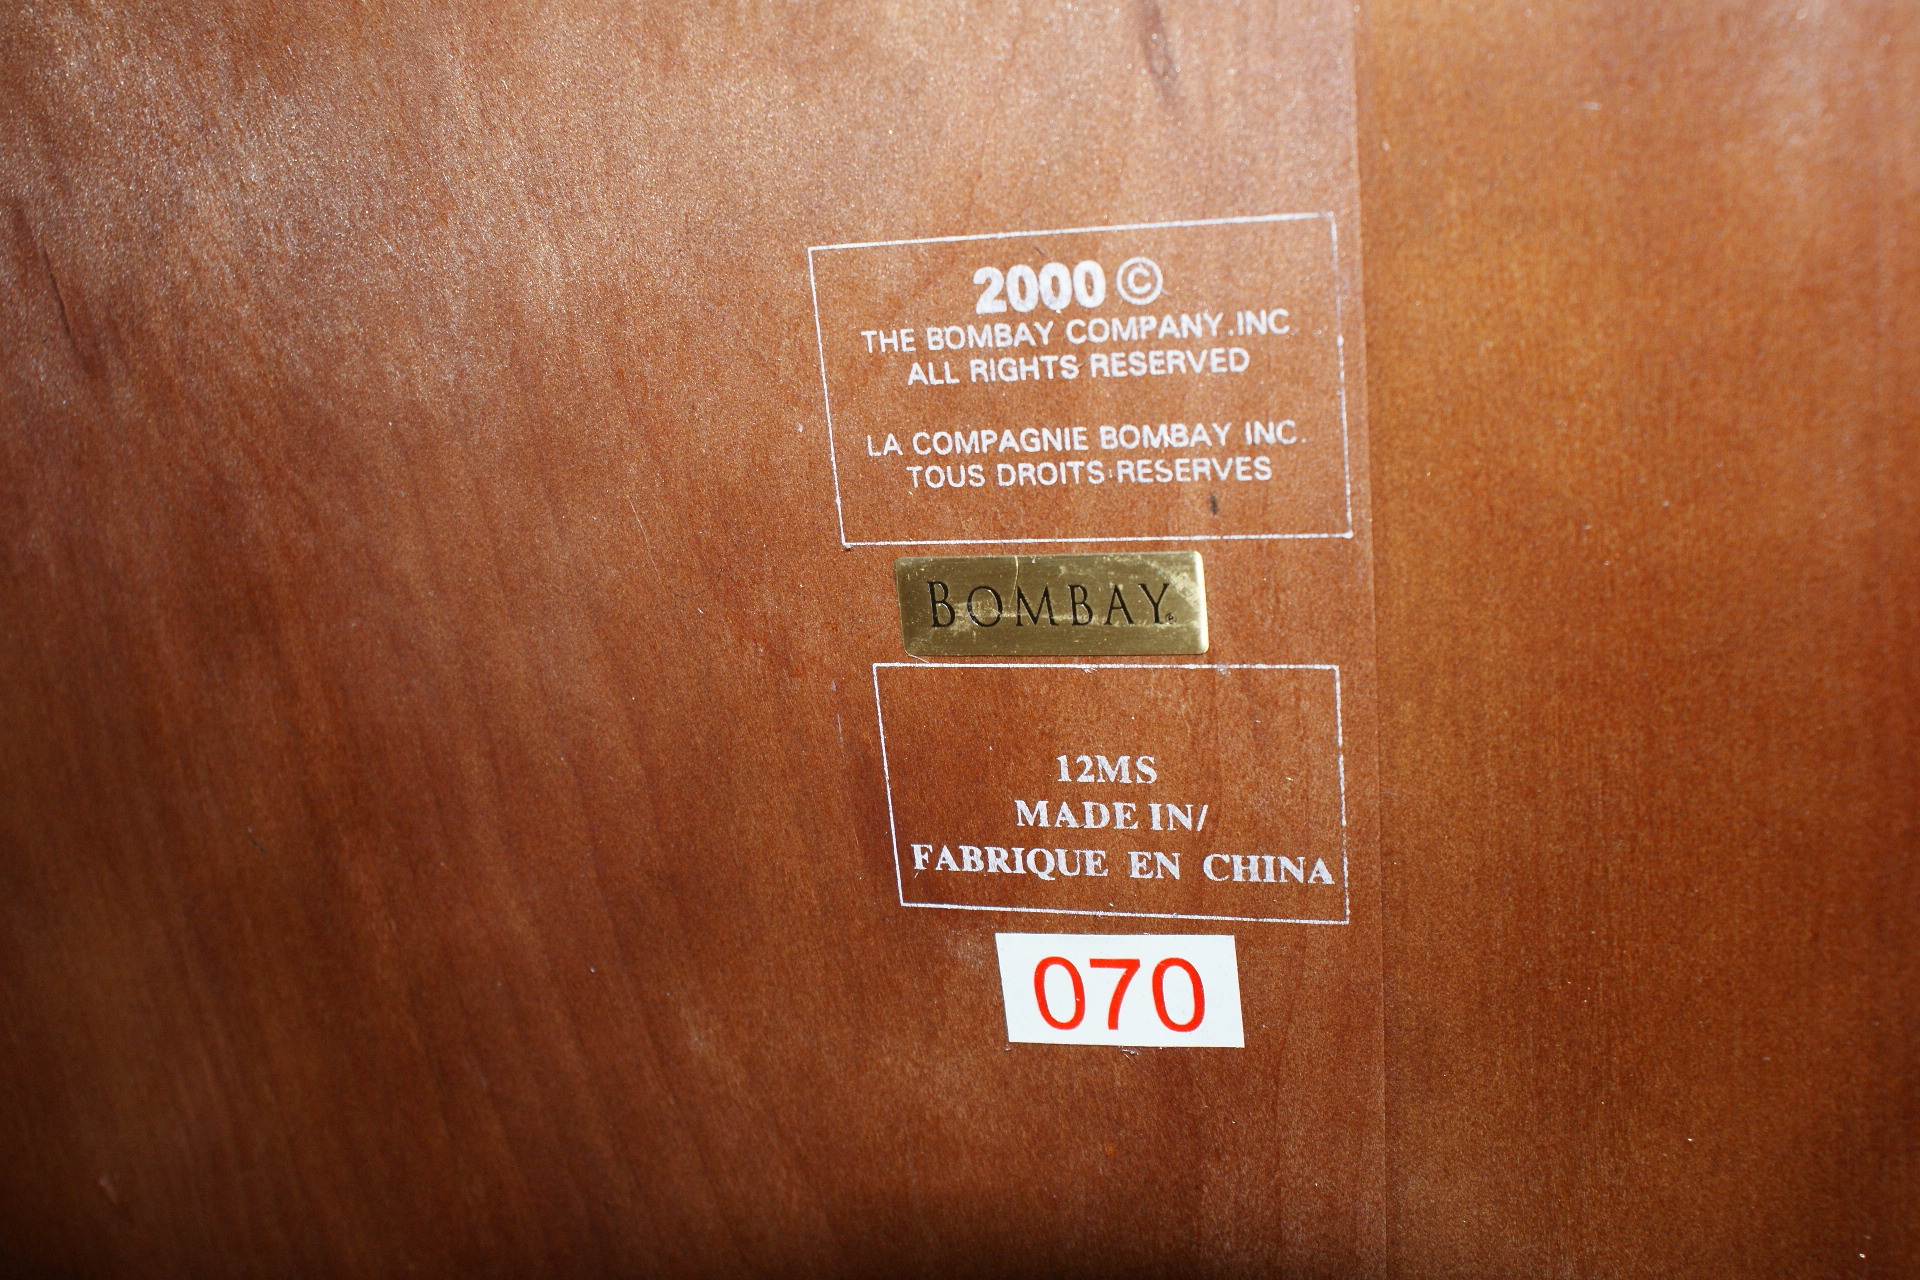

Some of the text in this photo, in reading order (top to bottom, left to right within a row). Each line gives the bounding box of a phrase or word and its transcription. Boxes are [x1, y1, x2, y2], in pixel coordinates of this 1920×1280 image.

[973, 260, 1106, 314] 2000
[861, 328, 916, 354] THE
[926, 321, 1053, 352] BOMBAY
[907, 348, 1250, 386] ALL RIGHTS RESERVED
[867, 420, 1307, 457] LA COMPAGNIE BOMBAY INC.
[907, 456, 1272, 488] TOUS DROITS RESERVES
[1057, 755, 1158, 784] 12MS
[1015, 800, 1209, 832] MADE IN/
[911, 843, 1335, 884] FABRIQUE EN CHINA
[1034, 956, 1205, 1033] 070
